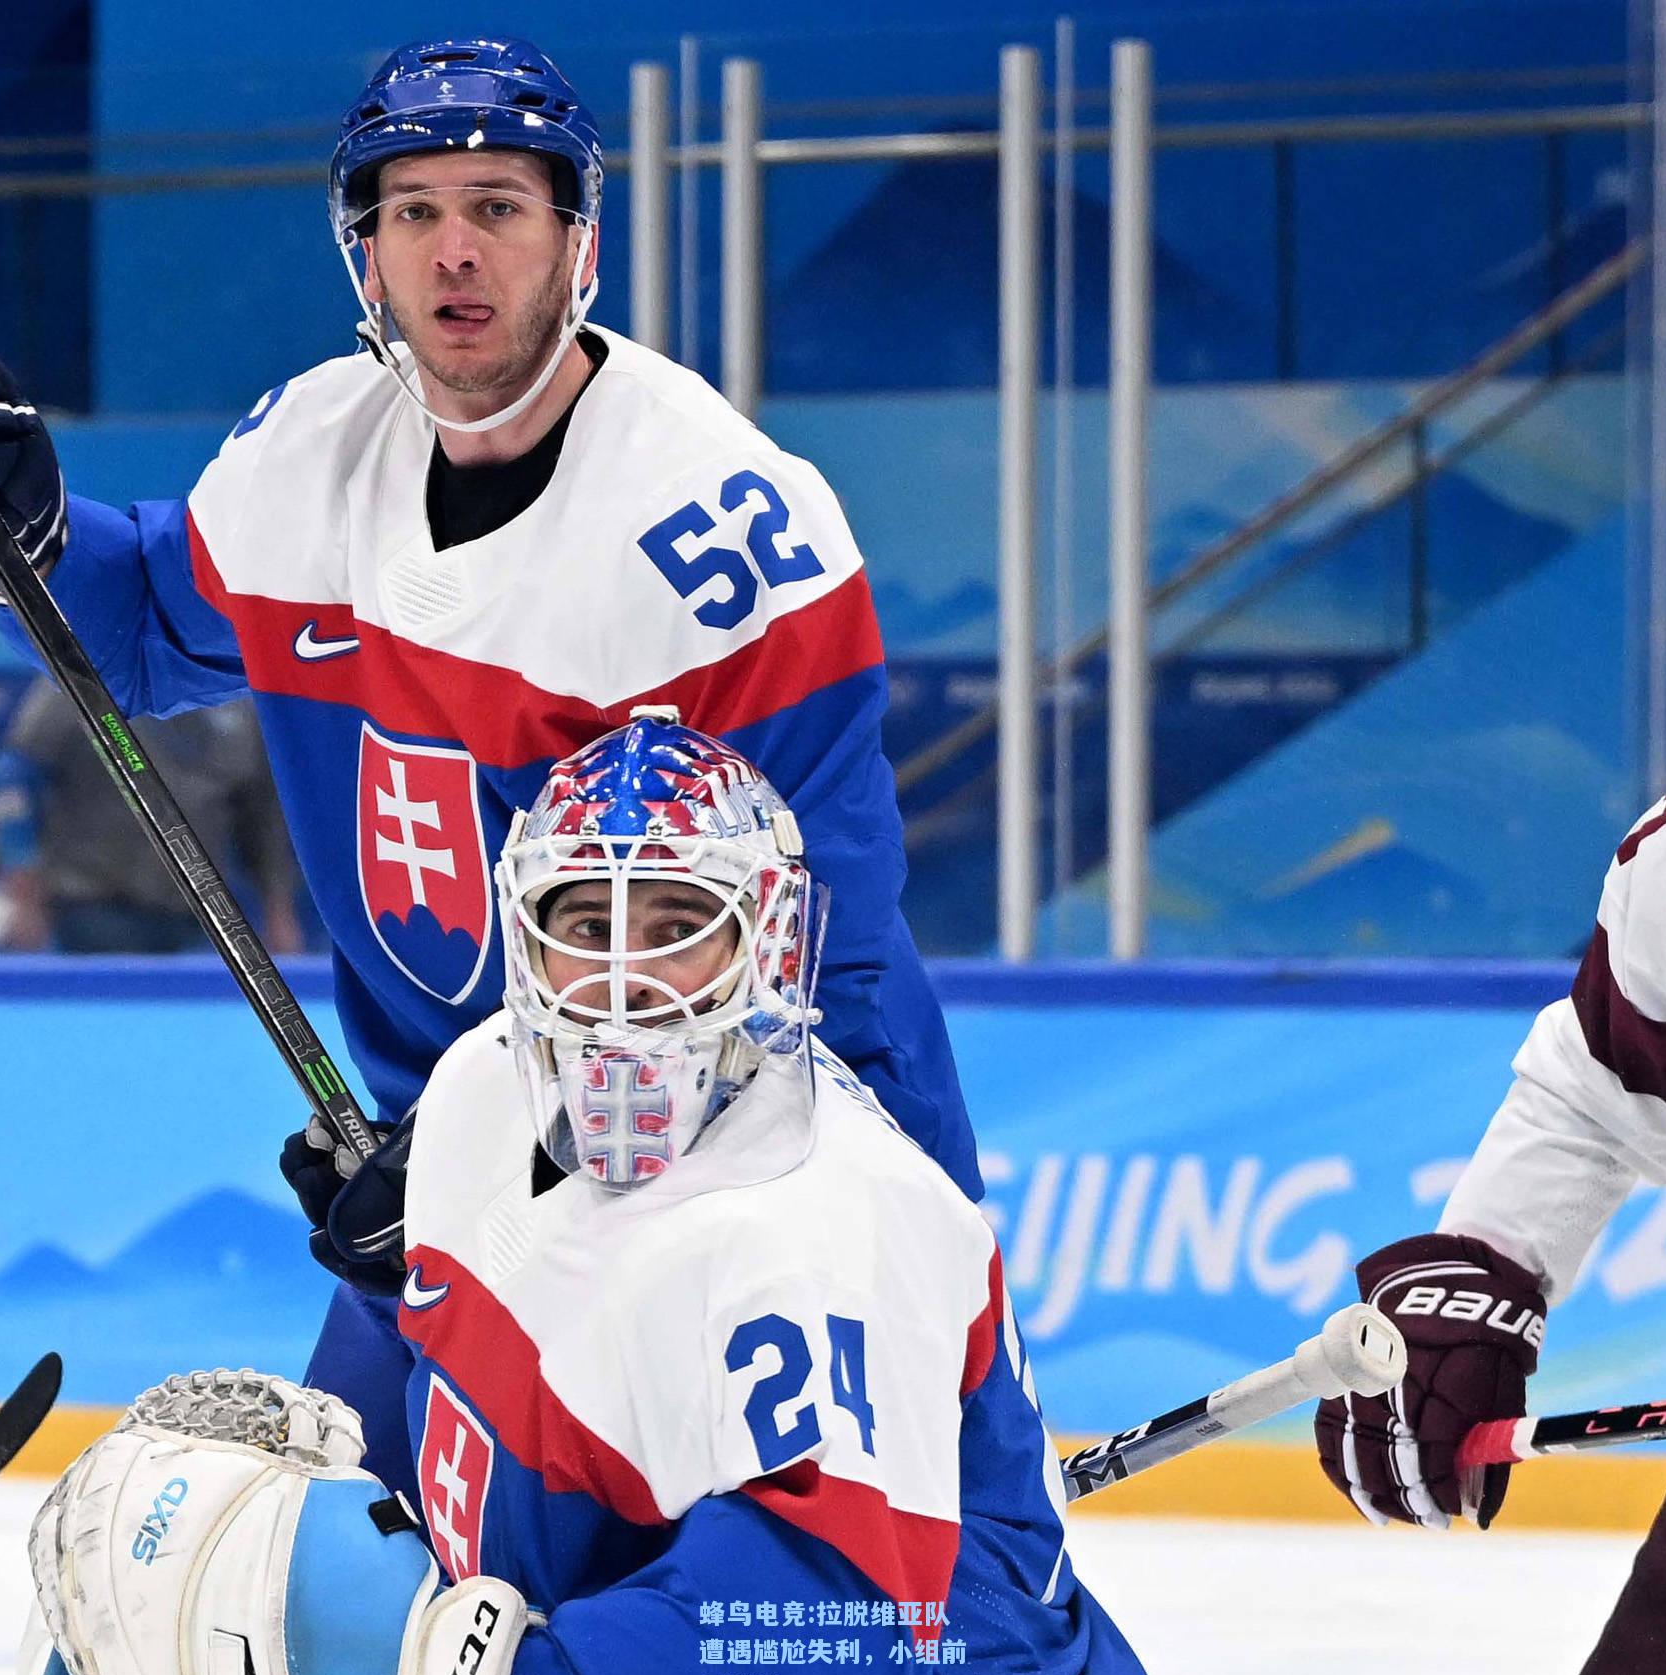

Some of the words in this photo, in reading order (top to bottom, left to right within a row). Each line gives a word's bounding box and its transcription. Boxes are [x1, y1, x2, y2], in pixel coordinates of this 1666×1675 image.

[637, 469, 825, 630] 52
[724, 1312, 877, 1473] 24
[1395, 1286, 1546, 1348] BAUE
